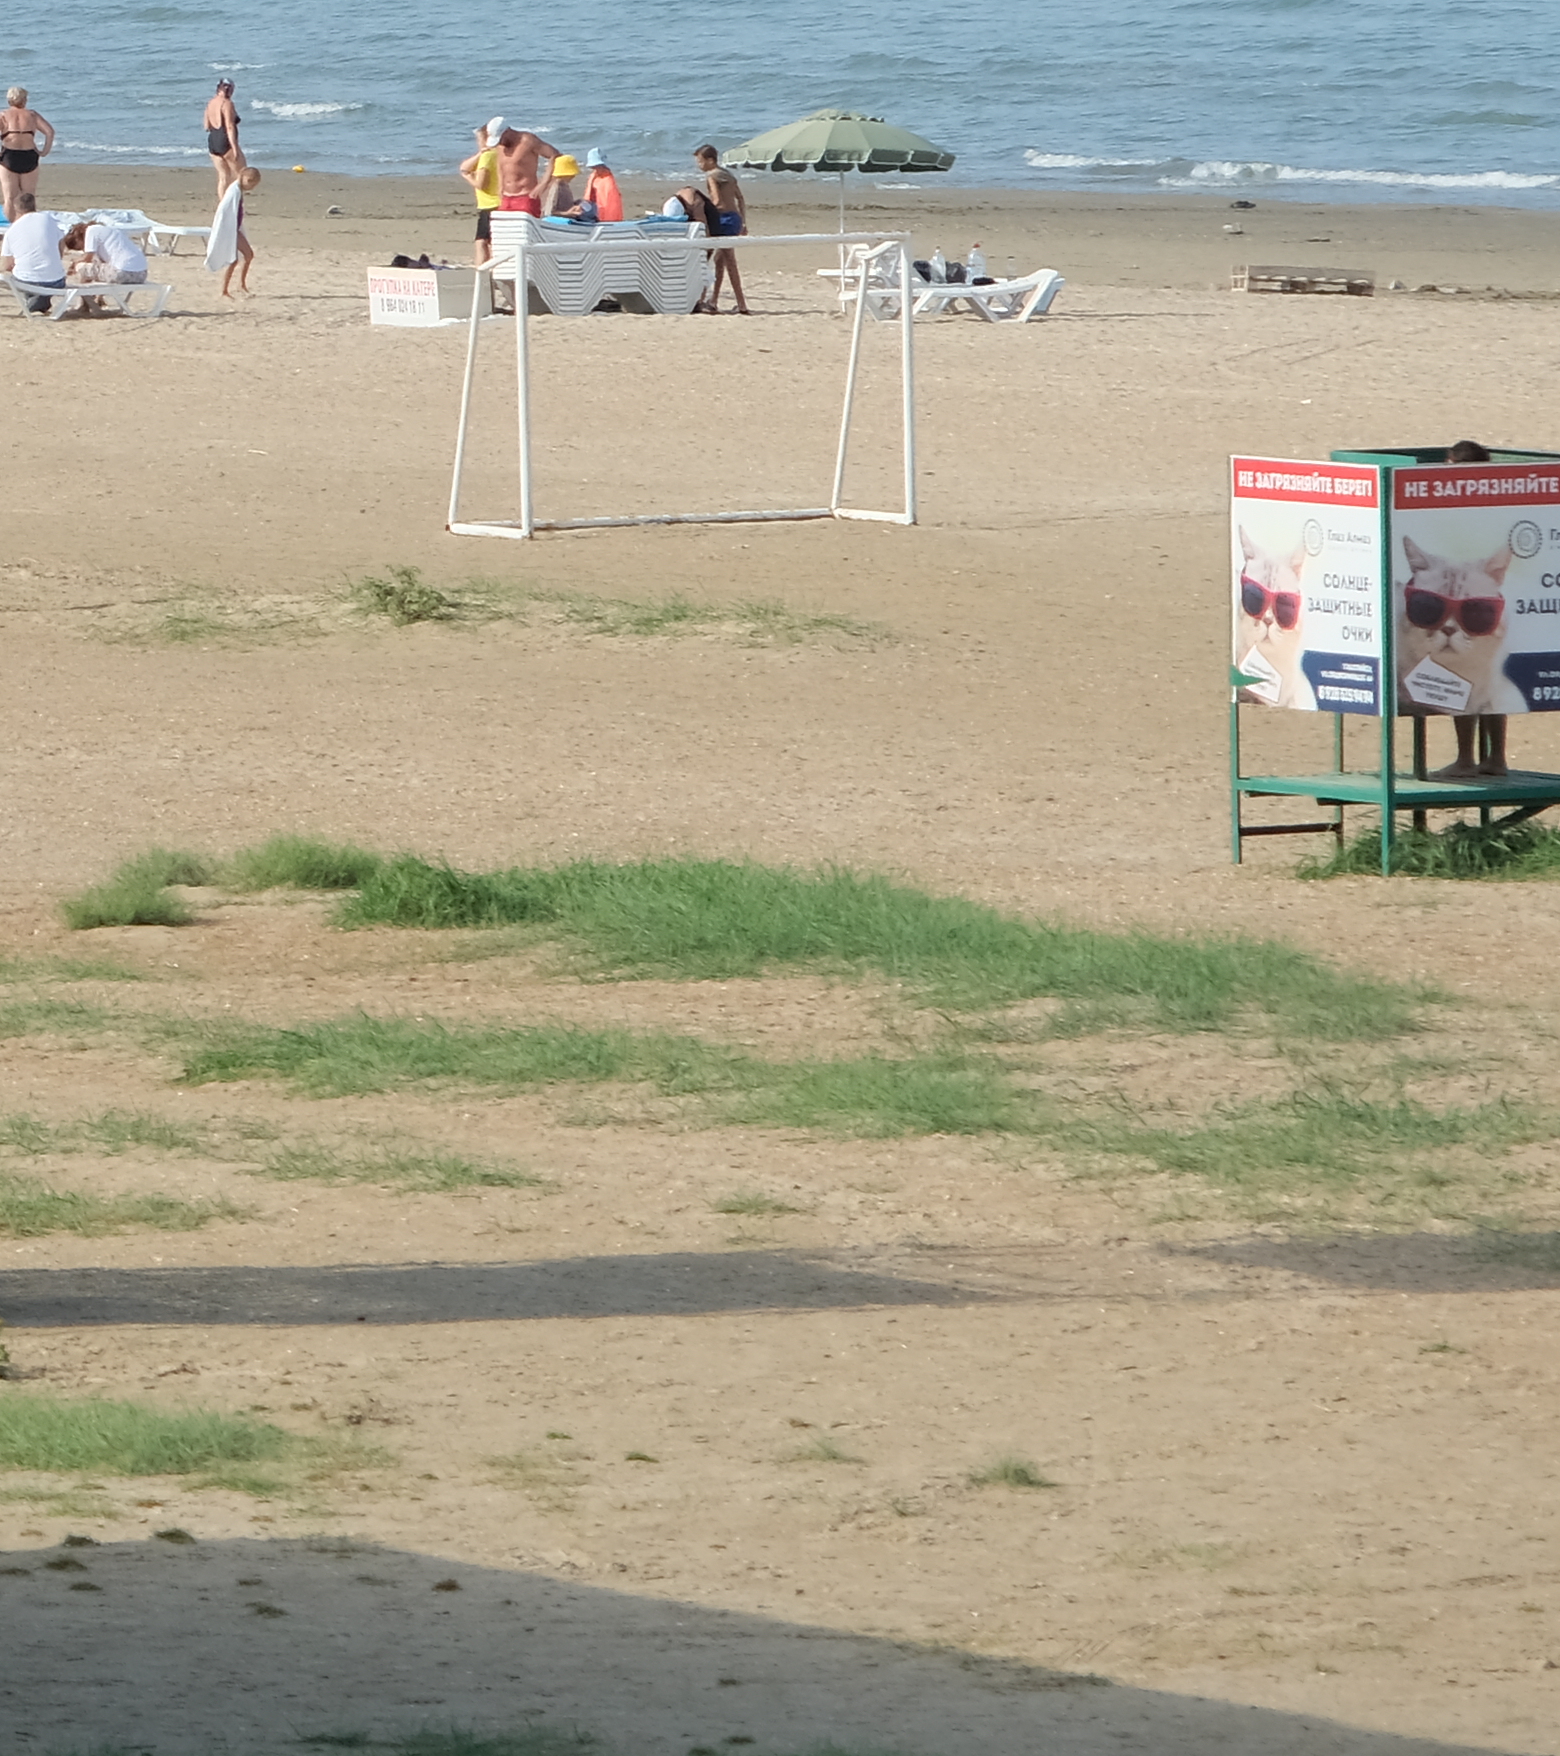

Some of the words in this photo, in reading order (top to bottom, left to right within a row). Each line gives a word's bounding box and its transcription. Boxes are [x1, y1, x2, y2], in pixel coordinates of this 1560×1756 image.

[403, 280, 411, 295] НА
[1238, 470, 1254, 487] НЕ
[1255, 471, 1333, 494] ЗАГРЯЗНЯЙТЕ
[1334, 477, 1373, 497] БЕРЕГ!
[1404, 481, 1429, 497] НЕ
[1432, 473, 1559, 497] ЗАГРЯЗНЯЙТЕ
[1308, 597, 1373, 617] ЗАЩИТНЫЕ
[1516, 598, 1560, 615] ЗАЩ
[1342, 625, 1373, 643] ОЧКИ
